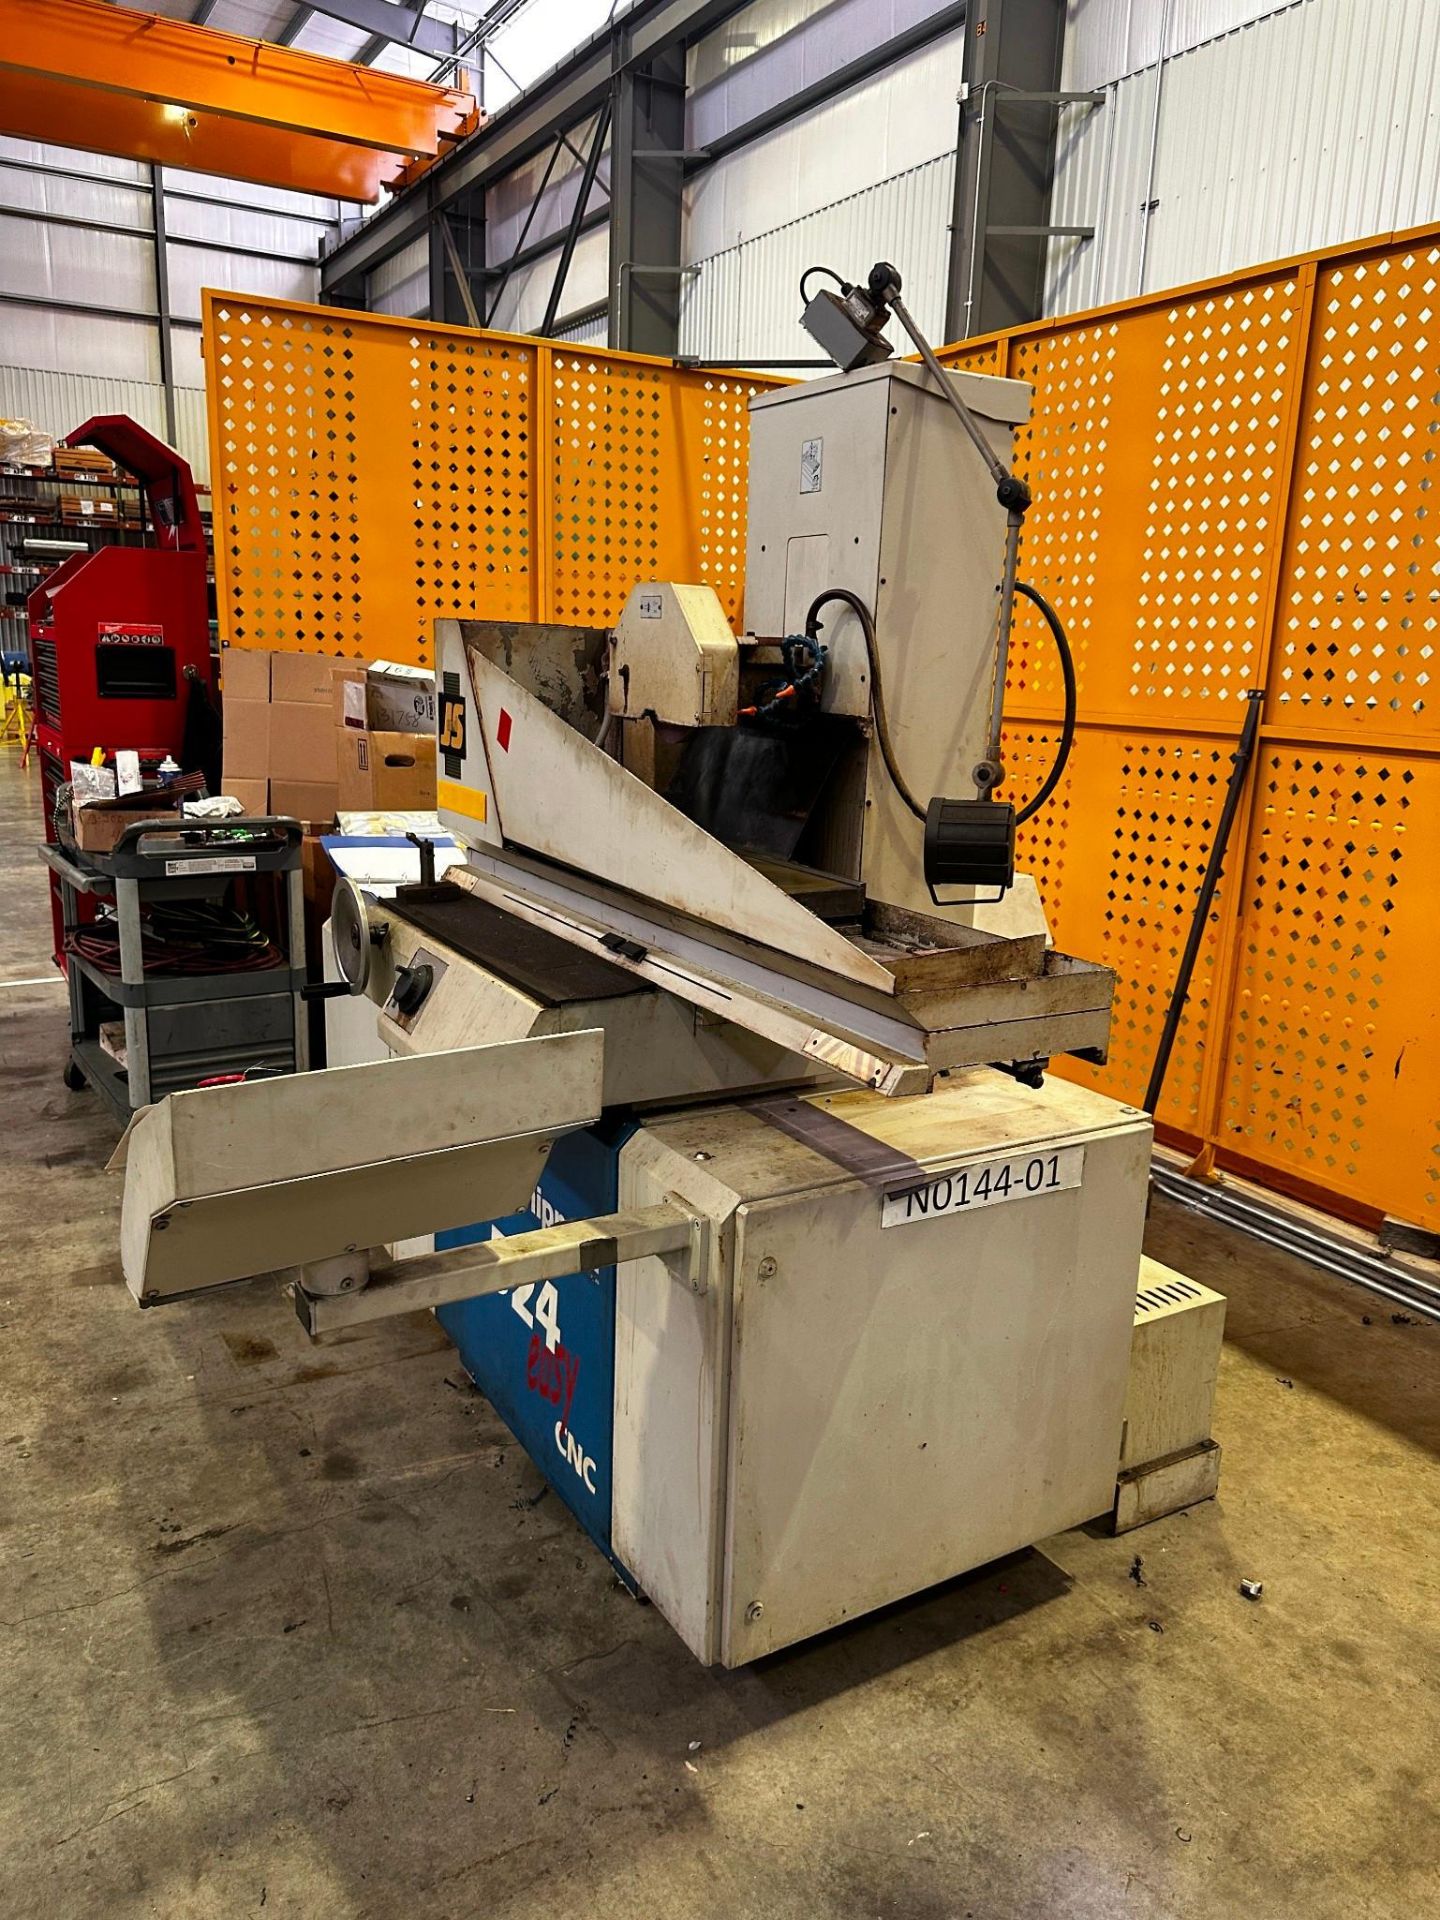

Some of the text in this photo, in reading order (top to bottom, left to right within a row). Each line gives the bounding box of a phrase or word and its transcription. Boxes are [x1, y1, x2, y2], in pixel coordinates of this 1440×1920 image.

[906, 1155, 1061, 1217] N0144-01
[498, 1280, 561, 1355] 24
[555, 1420, 597, 1495] CNC
